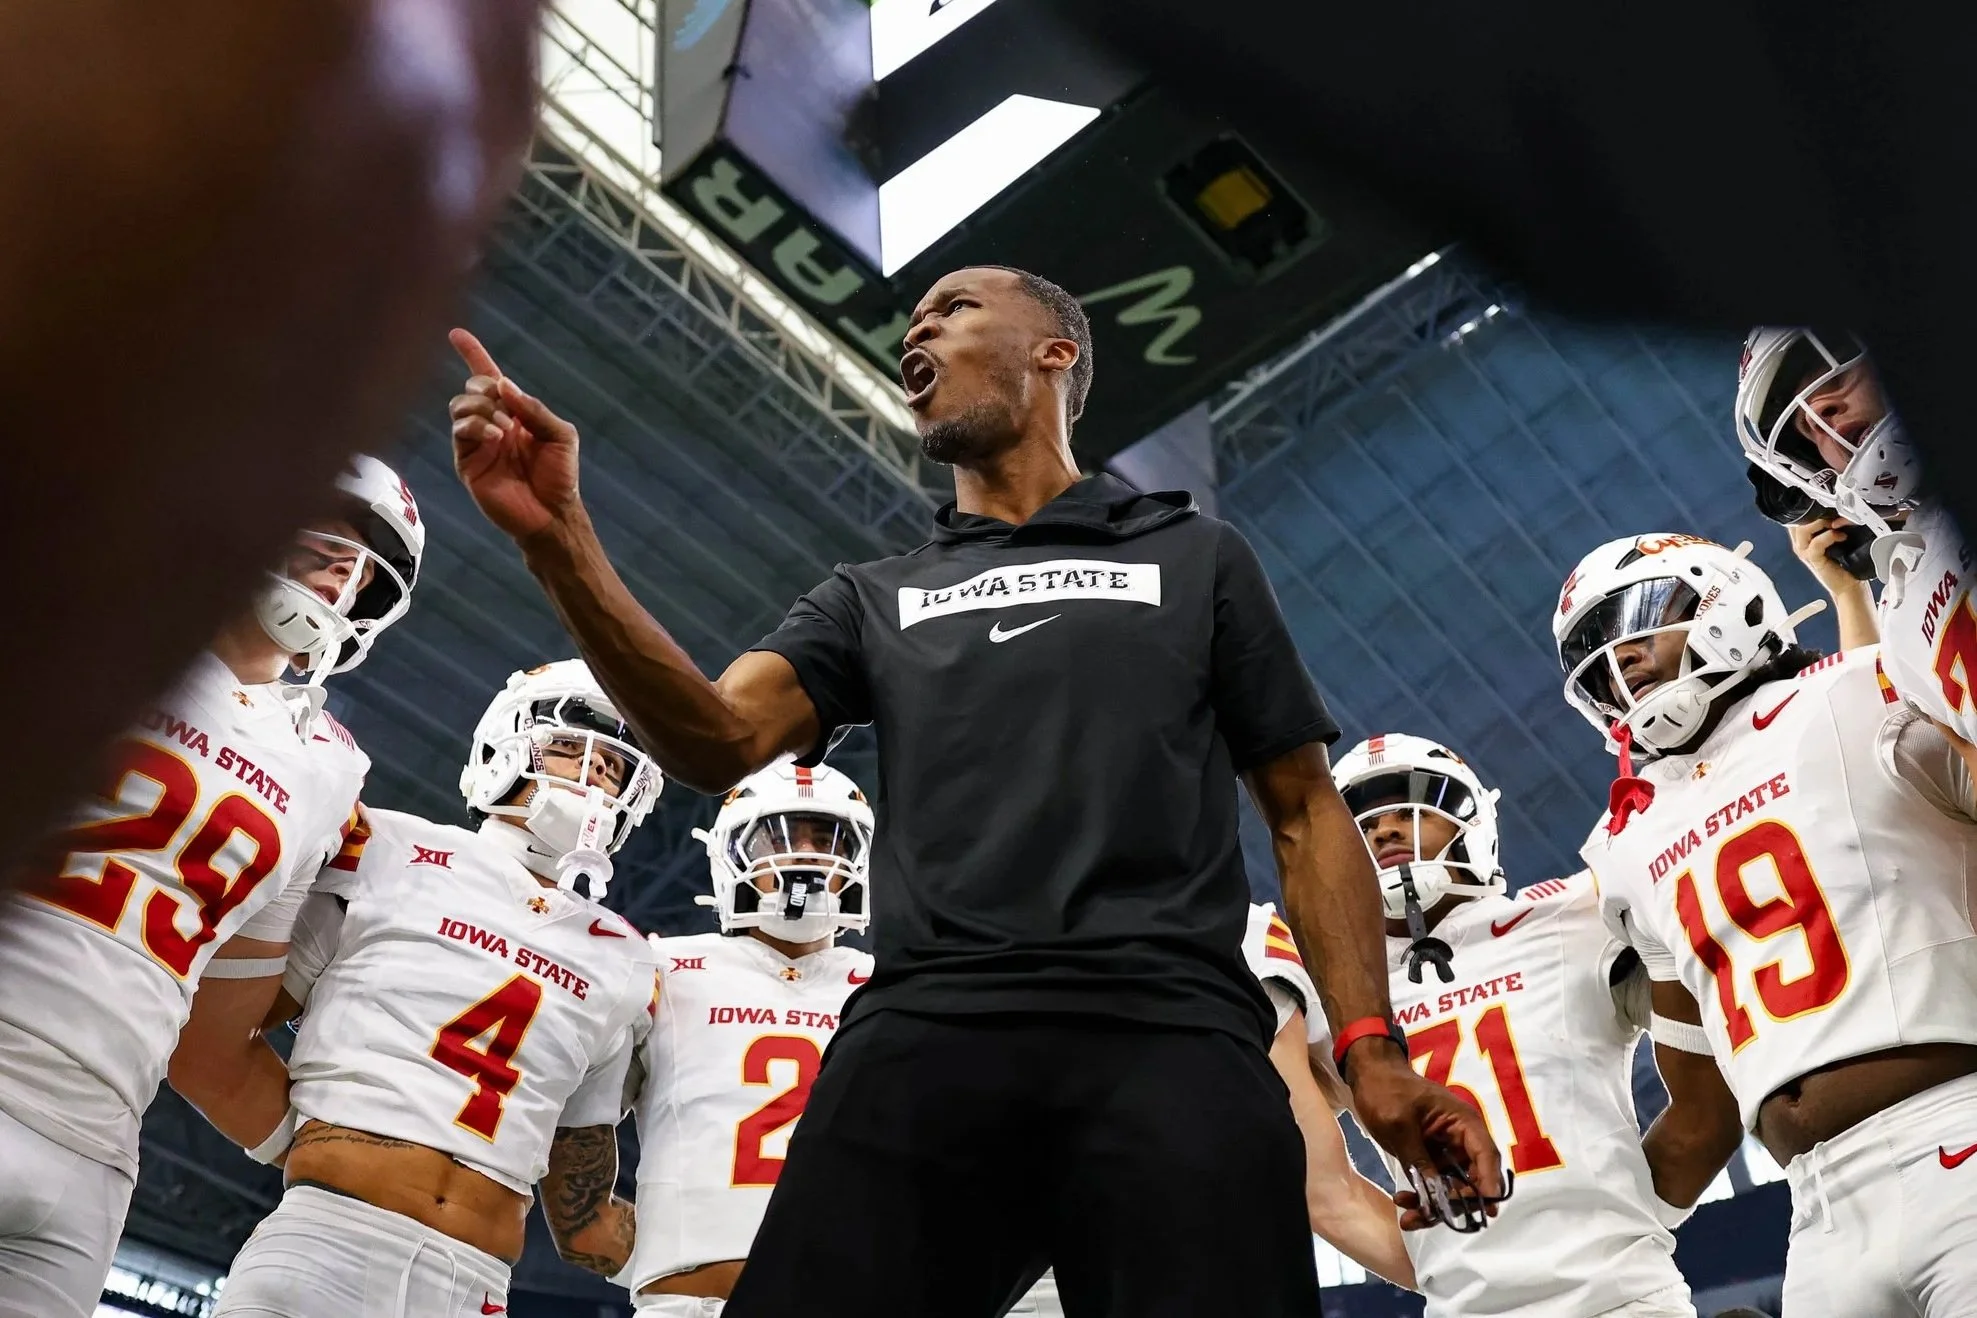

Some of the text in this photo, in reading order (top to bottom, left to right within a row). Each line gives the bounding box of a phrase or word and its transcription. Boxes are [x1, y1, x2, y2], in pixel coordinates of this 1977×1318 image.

[1018, 568, 1130, 593] STATE
[1921, 570, 1959, 648] IOWA
[215, 746, 291, 815] STATE
[12, 734, 282, 981] 29
[409, 844, 455, 870] XII
[1648, 772, 1791, 886] IOWA STATE
[437, 917, 590, 1001] IOWA STATE
[669, 956, 707, 973] XII
[1676, 817, 1852, 1061] 19
[708, 1007, 777, 1025] IOWA
[1392, 972, 1524, 1025] WA STATE
[427, 971, 544, 1145] 4
[729, 1032, 823, 1189] 2
